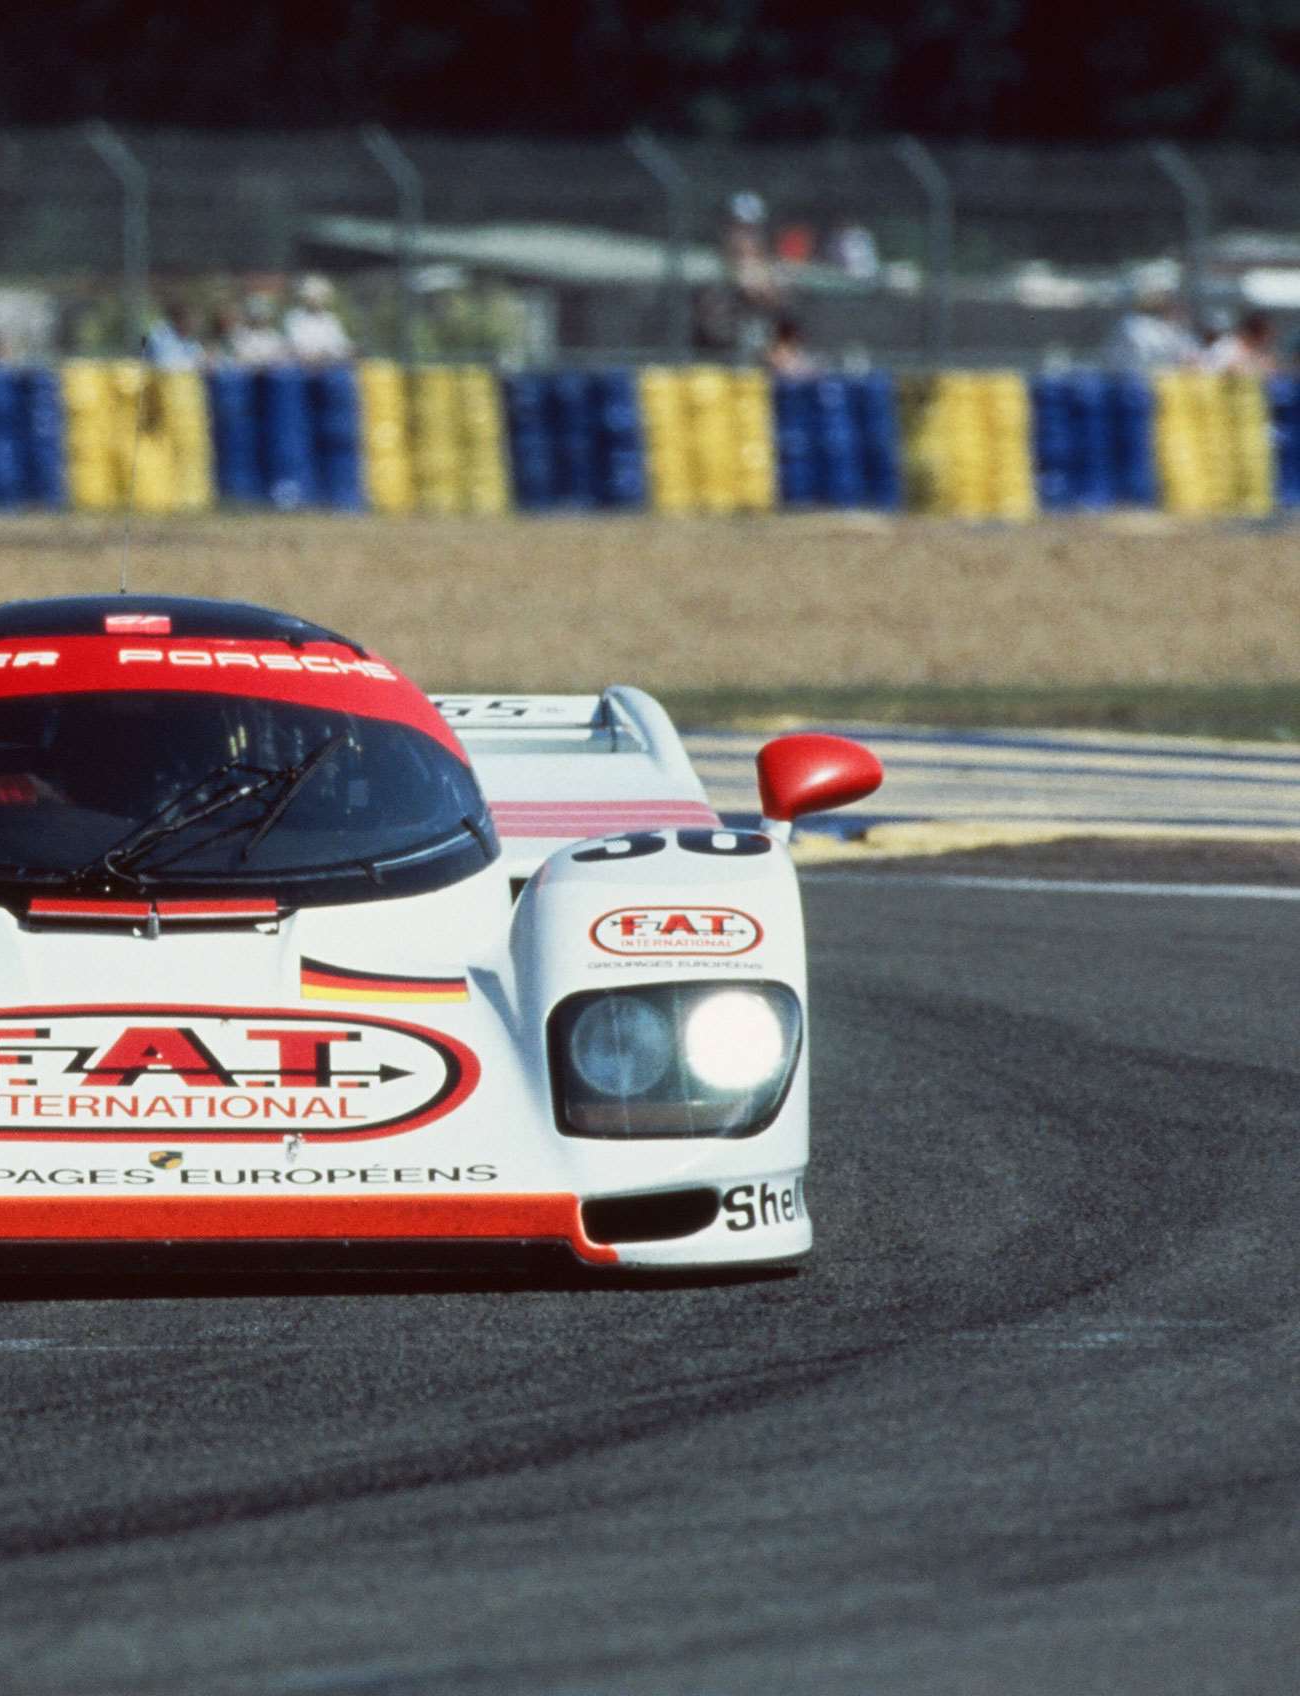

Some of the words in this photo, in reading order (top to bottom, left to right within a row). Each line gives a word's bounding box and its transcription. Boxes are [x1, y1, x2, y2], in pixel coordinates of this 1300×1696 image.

[118, 649, 398, 681] PORSCHE
[620, 937, 732, 948] INTERNATIONAL
[180, 1163, 499, 1185] EUROPÉENS
